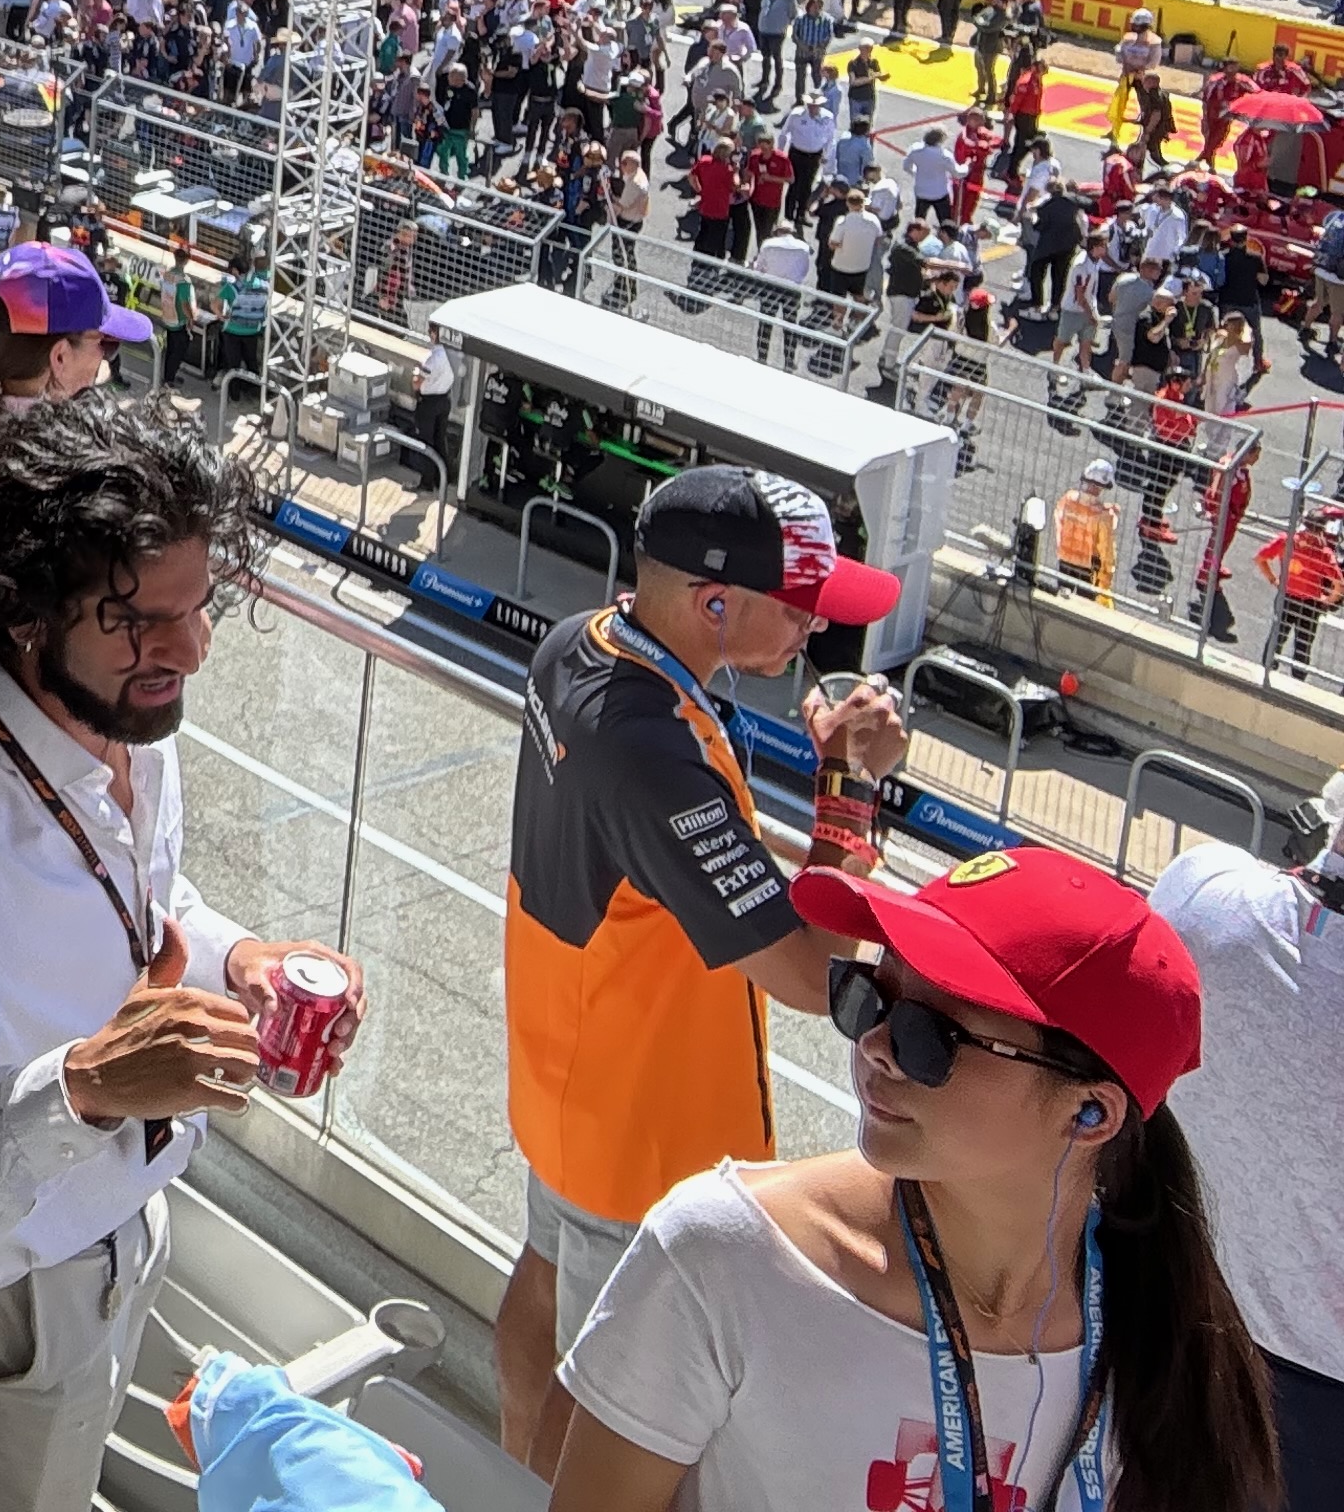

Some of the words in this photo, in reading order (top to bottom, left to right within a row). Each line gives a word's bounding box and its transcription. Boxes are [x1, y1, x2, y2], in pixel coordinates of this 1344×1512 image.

[496, 601, 549, 638] LIONES
[677, 806, 724, 834] Hilton
[713, 859, 766, 898] FxPro
[937, 1346, 965, 1472] AMERICAN
[1078, 1420, 1102, 1501] PRESS
